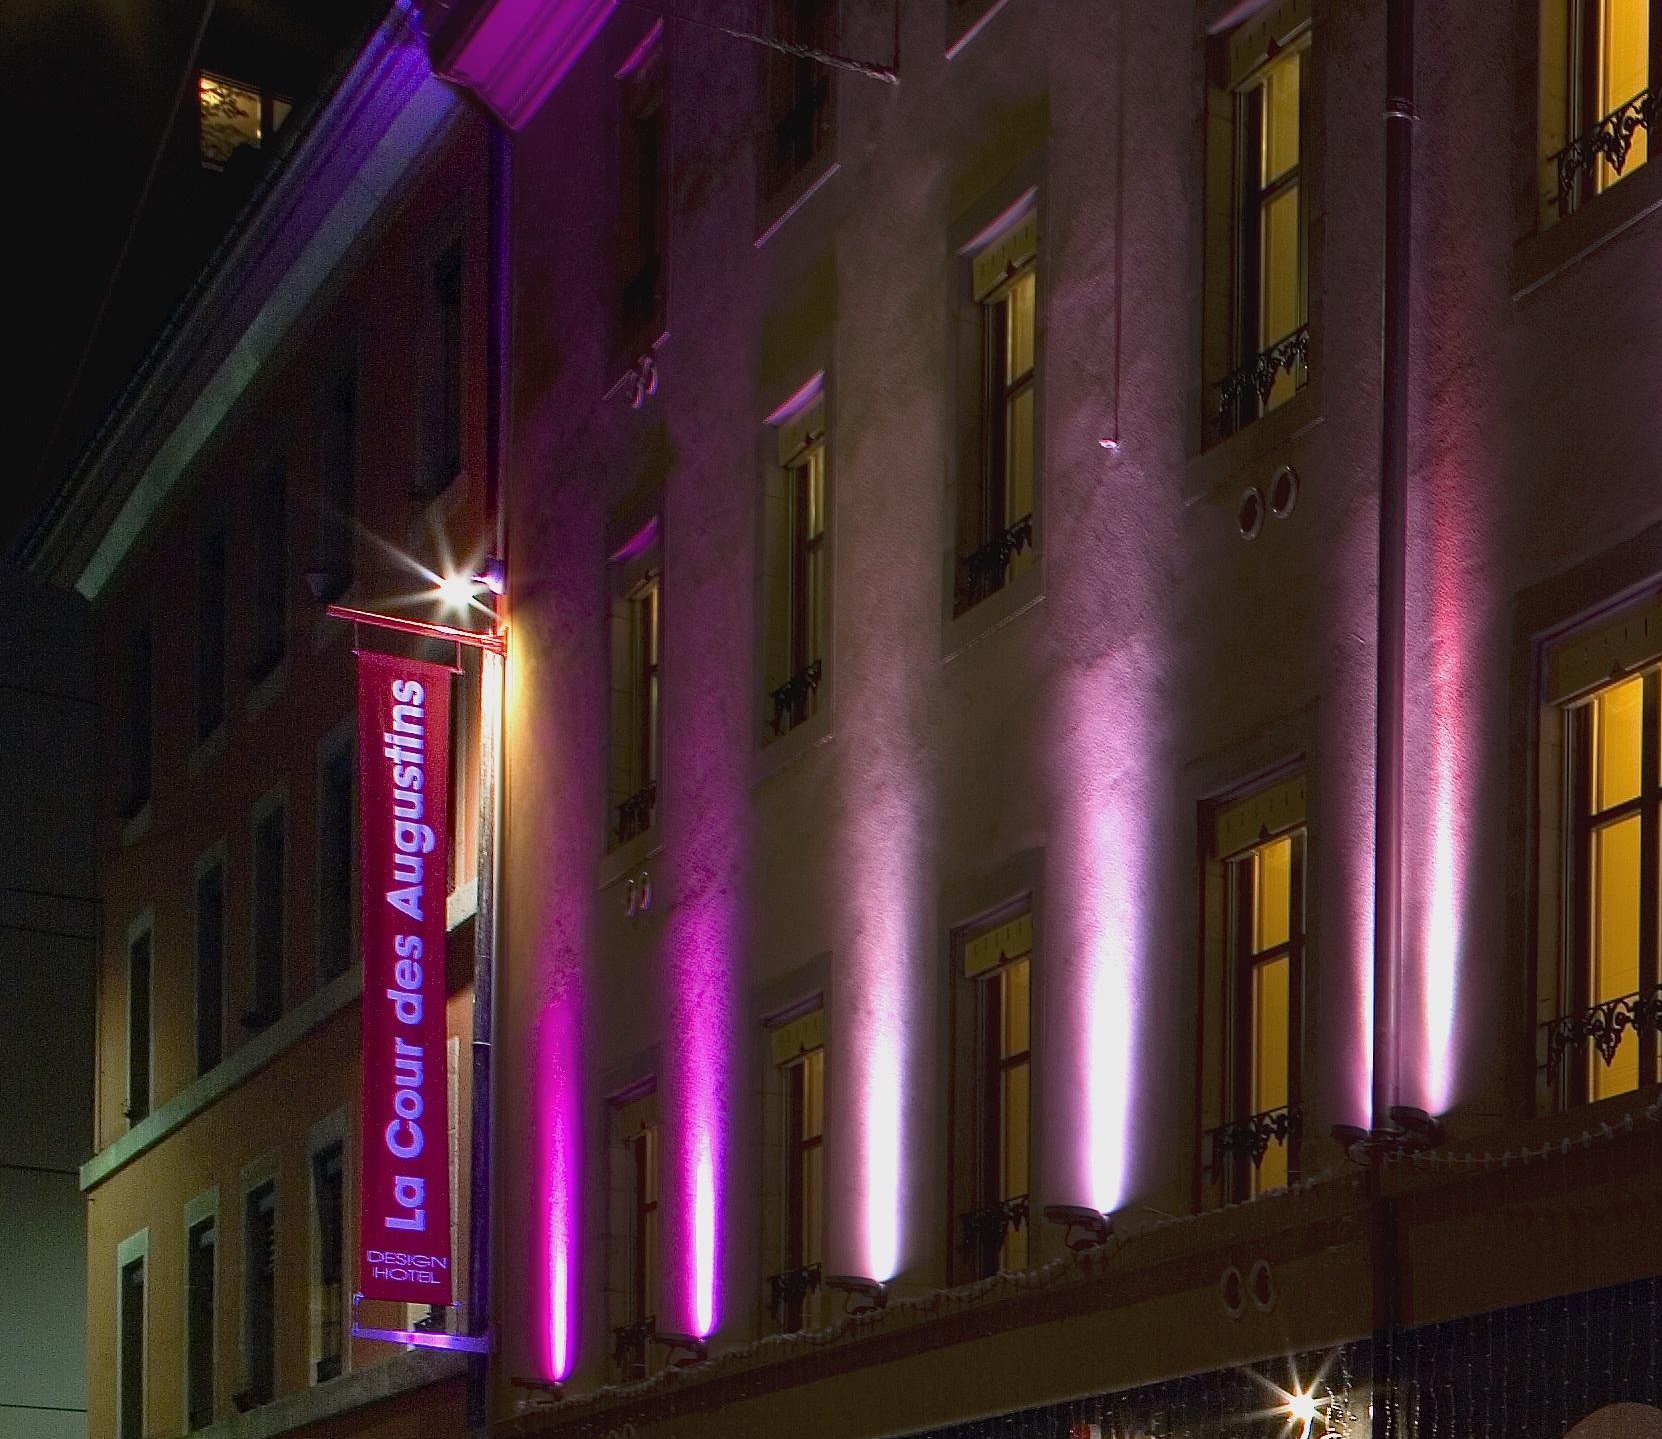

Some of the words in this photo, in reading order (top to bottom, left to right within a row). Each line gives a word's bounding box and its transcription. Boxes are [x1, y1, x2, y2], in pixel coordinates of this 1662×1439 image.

[384, 679, 436, 922] Augustins
[386, 934, 424, 1025] des
[385, 1036, 424, 1160] Cour
[384, 1174, 425, 1232] La
[367, 1250, 448, 1269] DESIGN
[373, 1267, 441, 1283] HOTEL
